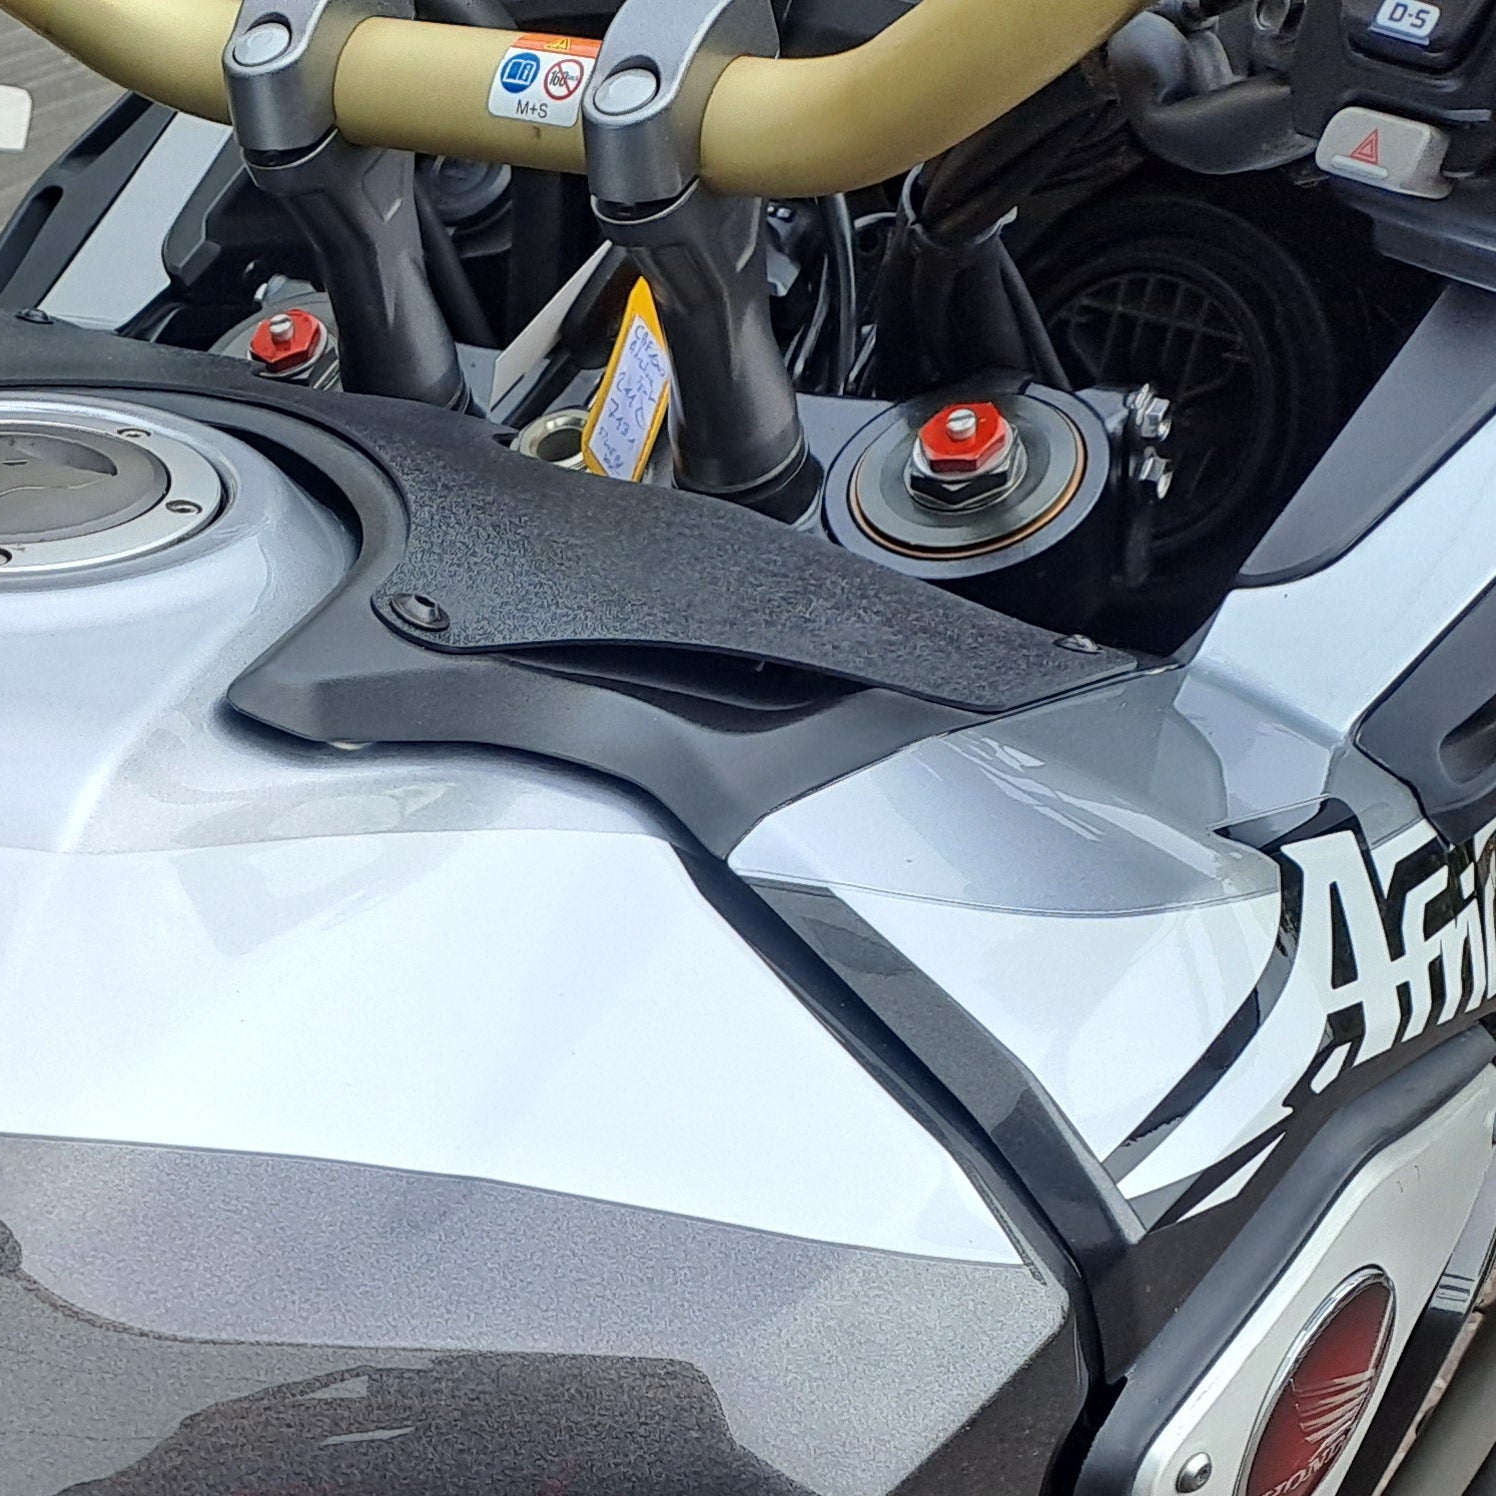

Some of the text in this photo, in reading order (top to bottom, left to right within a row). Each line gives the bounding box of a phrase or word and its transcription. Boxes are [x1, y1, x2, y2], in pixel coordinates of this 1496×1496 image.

[1387, 2, 1431, 29] D-S
[516, 99, 548, 119] M+S
[1280, 829, 1496, 1094] Afri
